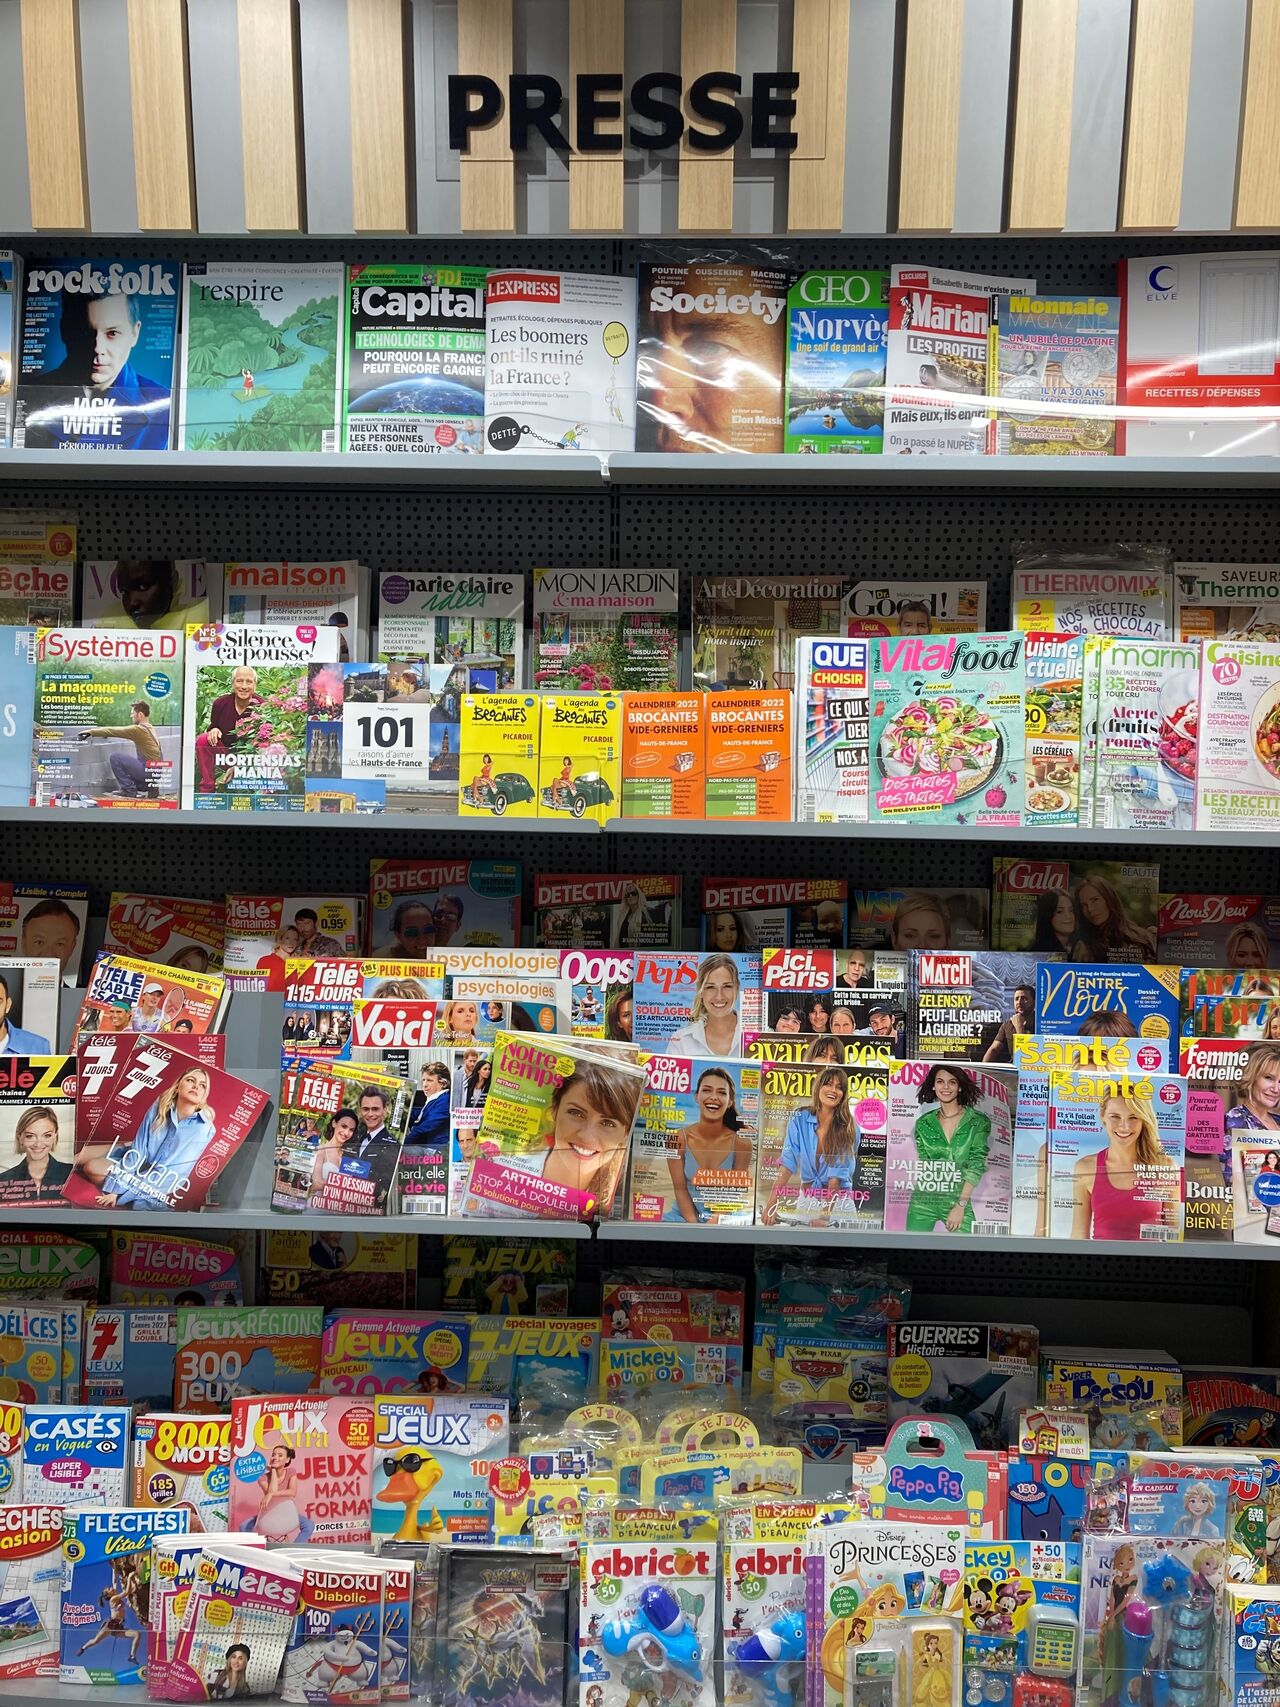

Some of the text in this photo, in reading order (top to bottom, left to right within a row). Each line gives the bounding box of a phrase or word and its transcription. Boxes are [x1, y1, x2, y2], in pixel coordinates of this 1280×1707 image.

[448, 72, 799, 153] PRESSE
[27, 263, 175, 296] rock&folk
[200, 280, 284, 306] respire
[488, 280, 558, 298] L'EXPRESS
[800, 275, 870, 303] GEO
[1147, 293, 1177, 301] ELVE
[362, 286, 482, 322] Capital
[650, 287, 786, 325] Society
[1010, 297, 1109, 315] Monnaie
[1008, 314, 1106, 329] MAGAZINE
[491, 328, 588, 345] Les boomers
[1008, 333, 1114, 346] UN JUBILÉ DE PLATINE
[491, 350, 584, 365] ont-ils ruiné
[63, 416, 122, 436] WHITE
[350, 424, 418, 434] MIEUX TRAITER
[491, 428, 518, 440] DETTE
[350, 434, 424, 443] LES PERSONNES
[230, 560, 345, 586] maison
[408, 576, 456, 593] marie
[460, 576, 513, 594] claire
[539, 573, 675, 595] MON JARDIN
[1020, 574, 1160, 593] THERMOMIX
[1093, 618, 1161, 636] CHOCOLAT
[49, 634, 176, 664] Système D
[814, 645, 864, 667] QUE
[814, 672, 863, 684] CHOISIR
[1215, 663, 1239, 678] 70
[41, 681, 135, 695] La maçonnerie
[1106, 678, 1125, 689] 35
[41, 693, 114, 705] comme les pros
[678, 700, 697, 708] 2022
[762, 699, 784, 707] 2022
[628, 711, 698, 723] BROCANTES
[711, 710, 784, 722] BROCANTES
[1112, 706, 1158, 719] Alerte
[357, 717, 413, 747] 101
[629, 725, 698, 734] VIDE-GRENIERS
[712, 724, 784, 733] VIDE-GRENIERS
[1033, 746, 1073, 756] LES CÉRÉALES
[1105, 739, 1158, 750] rouges
[216, 754, 301, 767] HORTENSIAS
[234, 766, 282, 778] MANIA
[374, 866, 465, 890] DETECTIVE
[808, 881, 841, 890] HORS-
[1009, 865, 1063, 890] Gala
[538, 880, 632, 904] DETECTIVE
[706, 882, 805, 908] DETECTIVE
[230, 900, 272, 919] Télé
[231, 919, 276, 929] semaines
[314, 963, 358, 986] Télé
[561, 952, 633, 992] Oops
[765, 967, 830, 988] Paris
[458, 980, 555, 999] psychologies
[1078, 978, 1122, 989] ENTRE
[298, 986, 362, 1001] 15 JOURS
[919, 995, 971, 1007] ZELENSKY
[636, 1007, 691, 1016] SOULAGER
[919, 1009, 1001, 1022] PEUT-IL GAGNER
[354, 1004, 432, 1047] Voici
[90, 1036, 116, 1046] télé
[147, 1044, 172, 1061] télé
[505, 1042, 557, 1070] Notre
[1021, 1040, 1130, 1066] santé
[1187, 1045, 1249, 1065] Femme
[83, 1046, 118, 1095] 7
[85, 1066, 113, 1075] JOURS
[655, 1058, 676, 1071] TOP
[1187, 1063, 1243, 1082] Actuelle
[120, 1053, 170, 1099] 7
[129, 1072, 156, 1087] JOURS
[500, 1058, 565, 1089] temps
[303, 1078, 341, 1099] TÉLÉ
[1058, 1076, 1154, 1100] santé
[302, 1098, 338, 1112] POCHE
[639, 1108, 685, 1122] MAIGRIS
[106, 1135, 190, 1199] Louane
[697, 1170, 748, 1179] SOULAGER
[907, 1167, 960, 1182] TROUVÉ
[502, 1169, 567, 1197] ARTHROSE
[1186, 1202, 1222, 1215] MON
[129, 1242, 221, 1273] Fléchés
[475, 1249, 554, 1273] JEUX
[178, 1312, 246, 1342] Jeux
[247, 1308, 321, 1336] RÉGIONS
[352, 1320, 421, 1334] Femme Actuelle
[506, 1319, 596, 1331] spécial voyages
[501, 1331, 581, 1357] JEUX
[899, 1326, 979, 1345] GUERRES
[907, 1343, 945, 1357] Histoire
[86, 1360, 122, 1372] JEUX
[180, 1351, 242, 1382] 300
[610, 1350, 676, 1370] Mickey
[1060, 1368, 1092, 1383] SUPER
[379, 1405, 428, 1416] SPECIAL
[30, 1413, 121, 1439] CASÉS
[377, 1415, 471, 1446] JEUX
[172, 1447, 230, 1463] MOTS
[50, 1469, 82, 1478] LISIBLE
[51, 1461, 81, 1470] SUPER
[297, 1454, 367, 1481] JEUX
[152, 1479, 173, 1491] 185
[891, 1470, 960, 1498] Peppa Pig
[1017, 1484, 1037, 1495] 150
[453, 1490, 472, 1499] Mots
[757, 1505, 815, 1518] EN CADEAU
[84, 1512, 177, 1533] FLÉCHÉS
[591, 1546, 710, 1578] abricot
[830, 1540, 959, 1575] PRINCESSES
[217, 1563, 296, 1605] Mêlés
[307, 1571, 378, 1591] SUDOKU
[744, 1581, 760, 1594] 50
[314, 1590, 366, 1602] Diabolic
[601, 1583, 617, 1598] 50
[307, 1608, 330, 1626] 100
